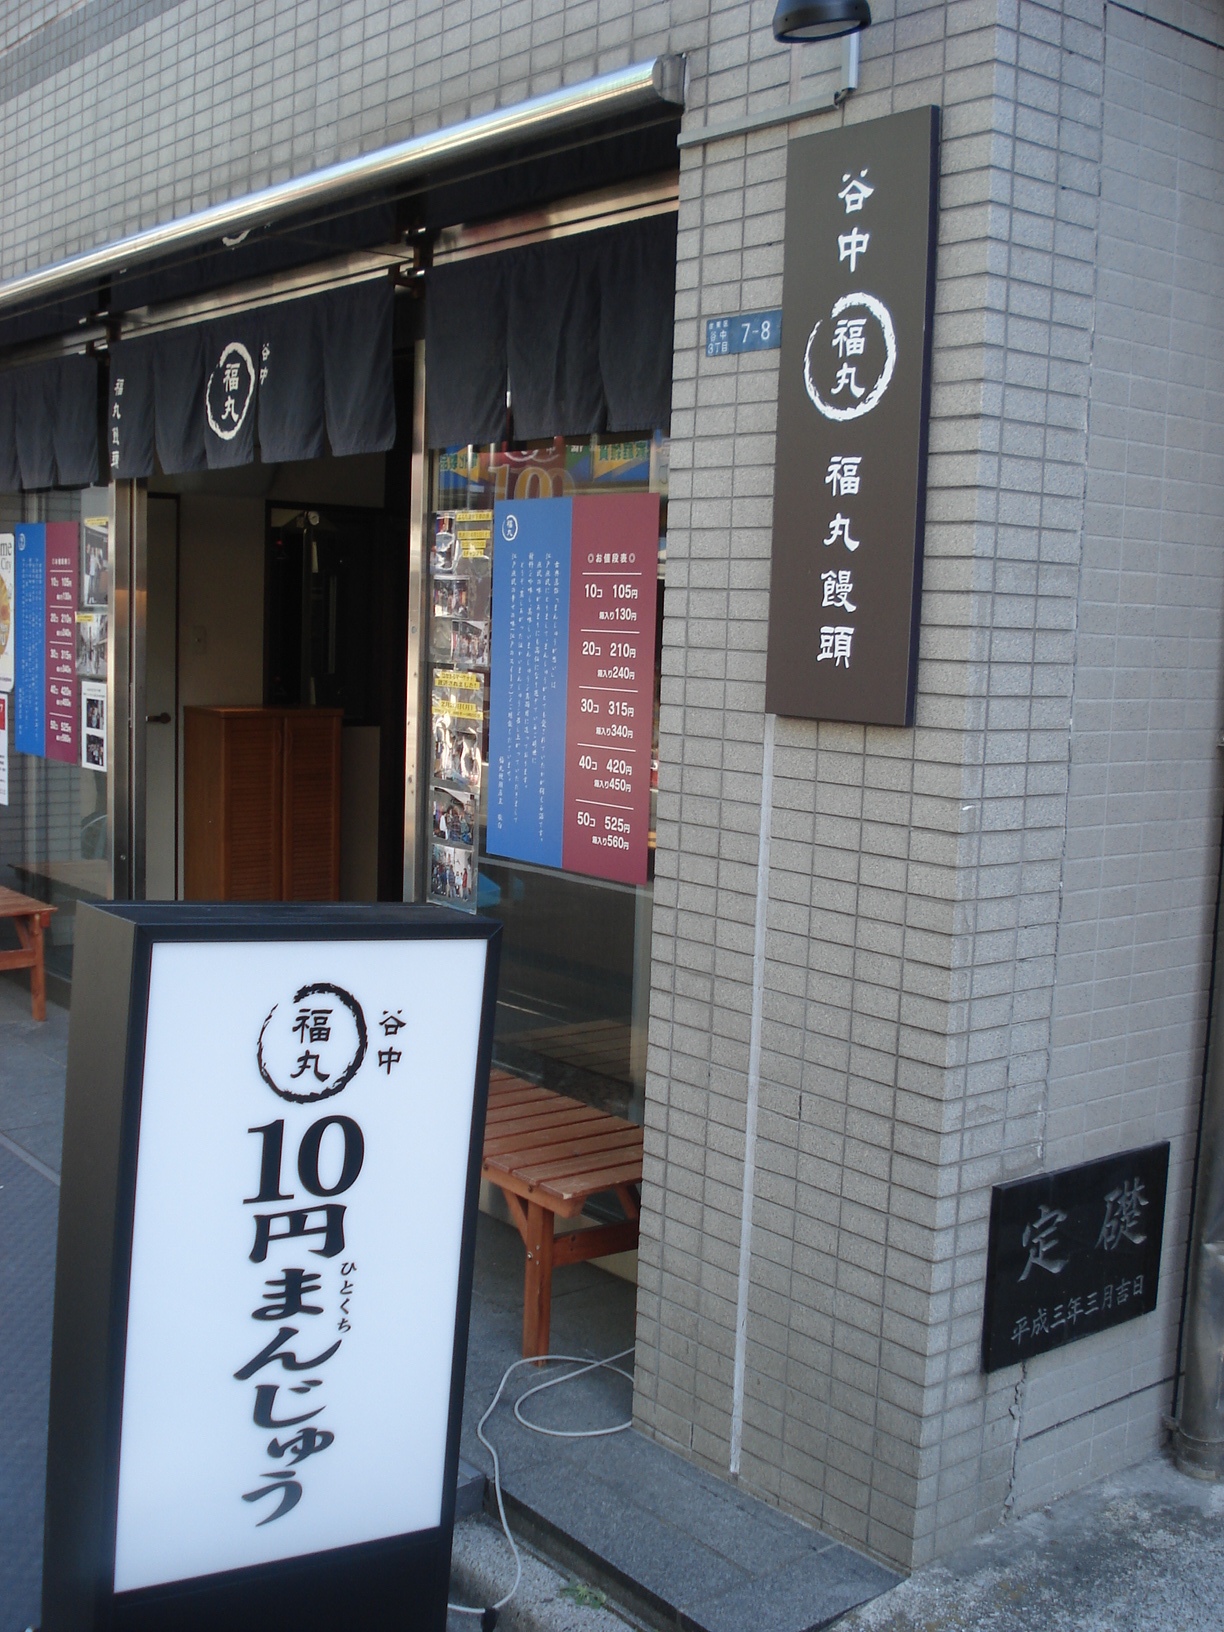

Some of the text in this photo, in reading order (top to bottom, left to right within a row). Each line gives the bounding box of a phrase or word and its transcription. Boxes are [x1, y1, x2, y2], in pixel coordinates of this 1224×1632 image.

[838, 168, 875, 273] 谷中
[259, 342, 271, 386] 谷中
[708, 341, 728, 354] 3丁目
[741, 320, 771, 344] 7-8
[830, 318, 867, 399] 福丸
[221, 362, 241, 423] 福丸
[585, 584, 638, 599] 10コ 105円
[816, 456, 863, 669] 福丸饅頭
[582, 641, 636, 658] 20コ 210円
[580, 698, 635, 717] 30コ 315円
[579, 756, 632, 776] 40コ 420円
[577, 812, 630, 834] 50コ 525円
[290, 1007, 333, 1084] 福丸
[377, 1009, 407, 1076] 谷中
[1016, 1176, 1149, 1283] 定礎
[233, 1114, 365, 1528] 10円まんじゅう
[335, 1260, 358, 1333] ひとくち
[1010, 1274, 1145, 1346] 平成三年三月吉日
